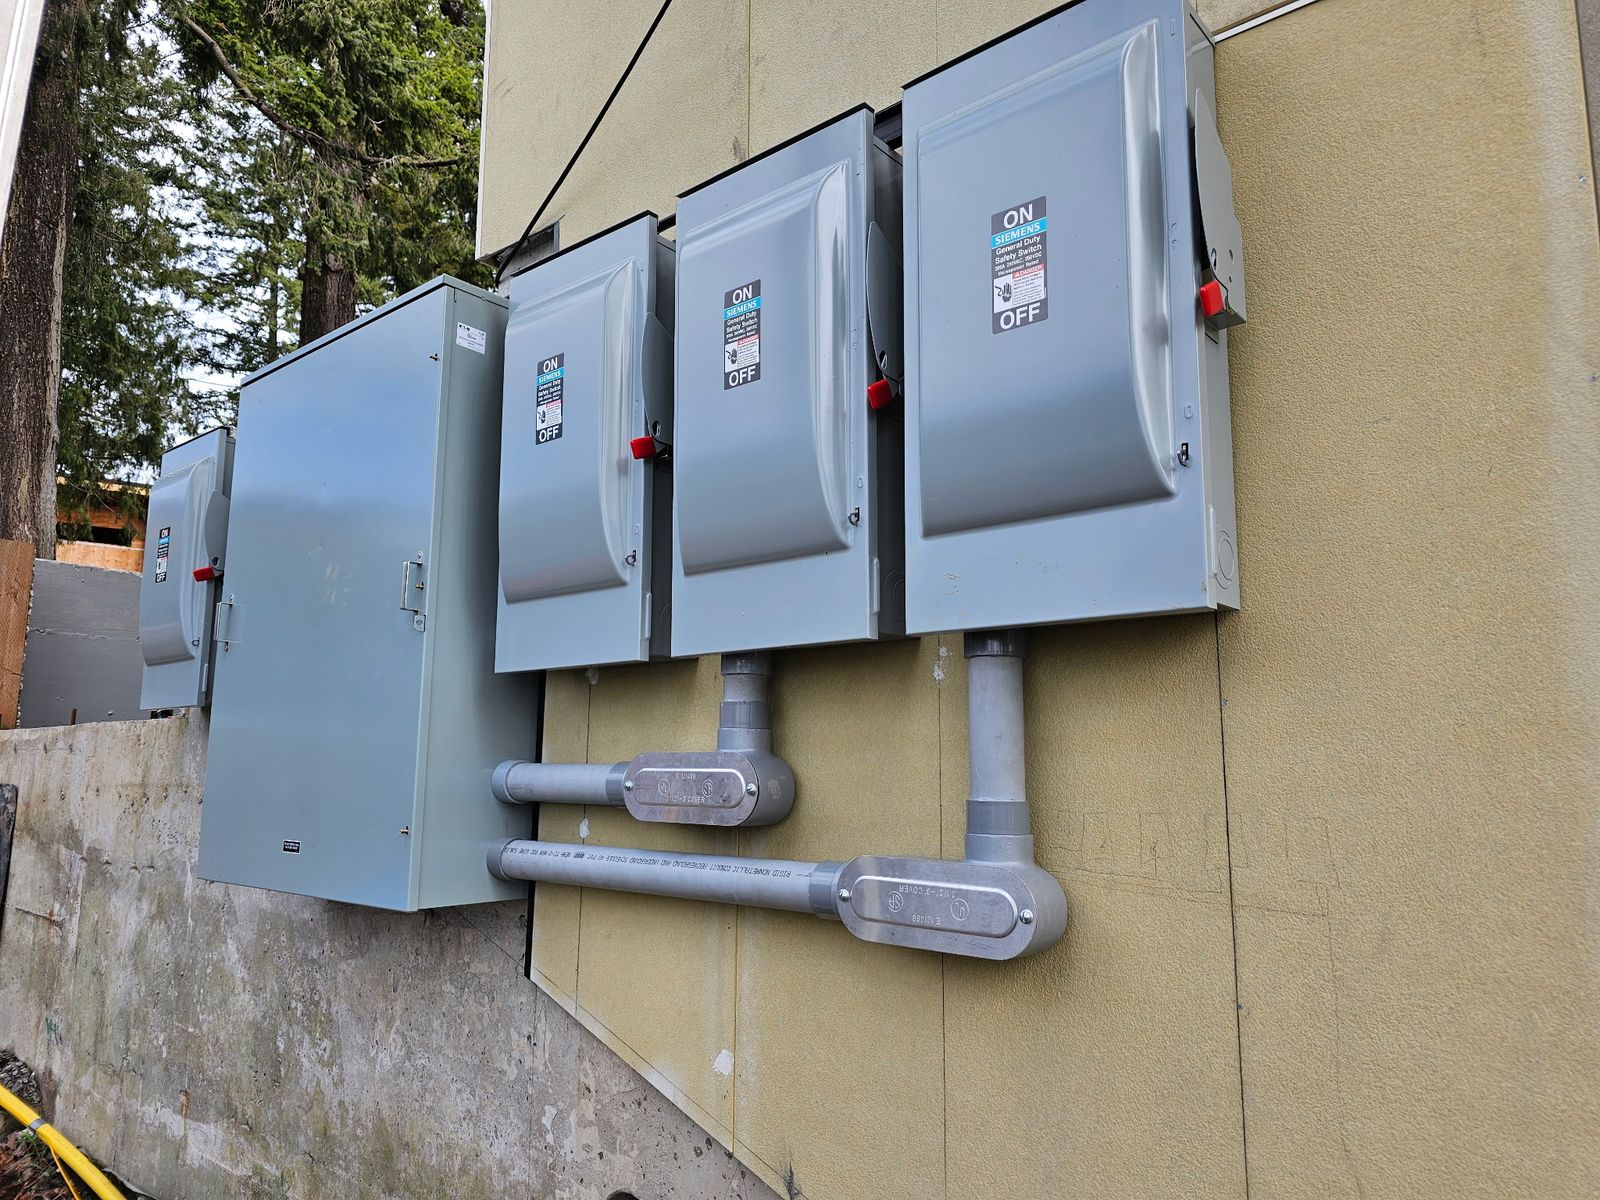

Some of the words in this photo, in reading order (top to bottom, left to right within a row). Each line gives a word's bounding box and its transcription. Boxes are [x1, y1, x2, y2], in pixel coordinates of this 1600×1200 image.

[1003, 203, 1033, 229] ON
[994, 222, 1041, 246] SIEMENS
[994, 251, 1018, 265] Safety
[1018, 243, 1042, 257] Switch
[995, 240, 1023, 256] General
[1024, 235, 1041, 248] Duty
[732, 285, 753, 305] ON
[726, 300, 757, 318] SIEMENS
[999, 302, 1041, 330] OFF
[726, 313, 746, 326] General
[745, 310, 757, 320] Duty
[726, 323, 741, 334] Safety
[741, 317, 758, 328] Switch
[543, 357, 558, 373] ON
[538, 369, 561, 384] SIEMENS
[728, 366, 756, 387] OFF
[538, 425, 559, 443] OFF
[162, 529, 168, 537] ON
[157, 573, 165, 582] OFF
[709, 862, 731, 872] CONDUIT
[732, 864, 770, 876] NONMETALLIC
[771, 868, 792, 878] RIGID
[898, 884, 923, 895] COVER
